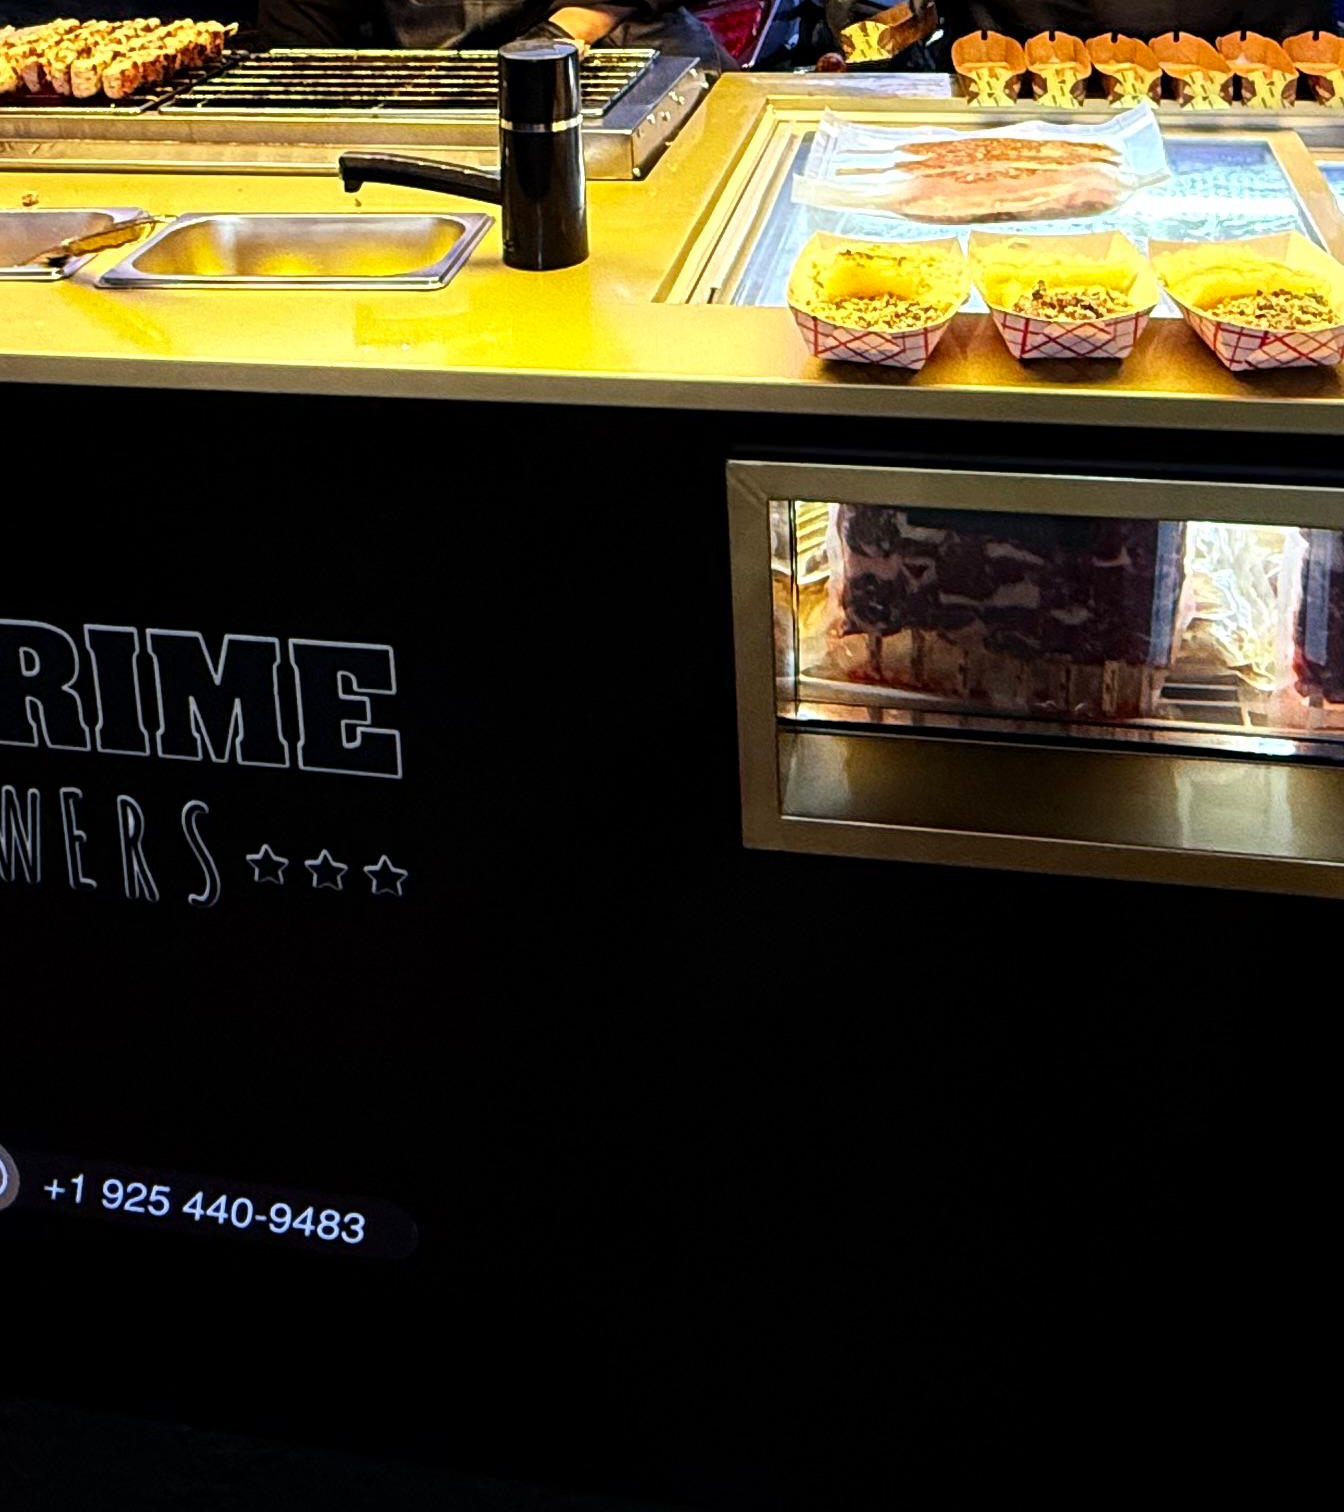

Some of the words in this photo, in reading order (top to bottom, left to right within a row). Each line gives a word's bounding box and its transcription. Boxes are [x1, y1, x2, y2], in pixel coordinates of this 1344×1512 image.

[43, 1173, 86, 1204] +1
[101, 1178, 172, 1216] 925
[182, 1191, 367, 1245] 440-9483
